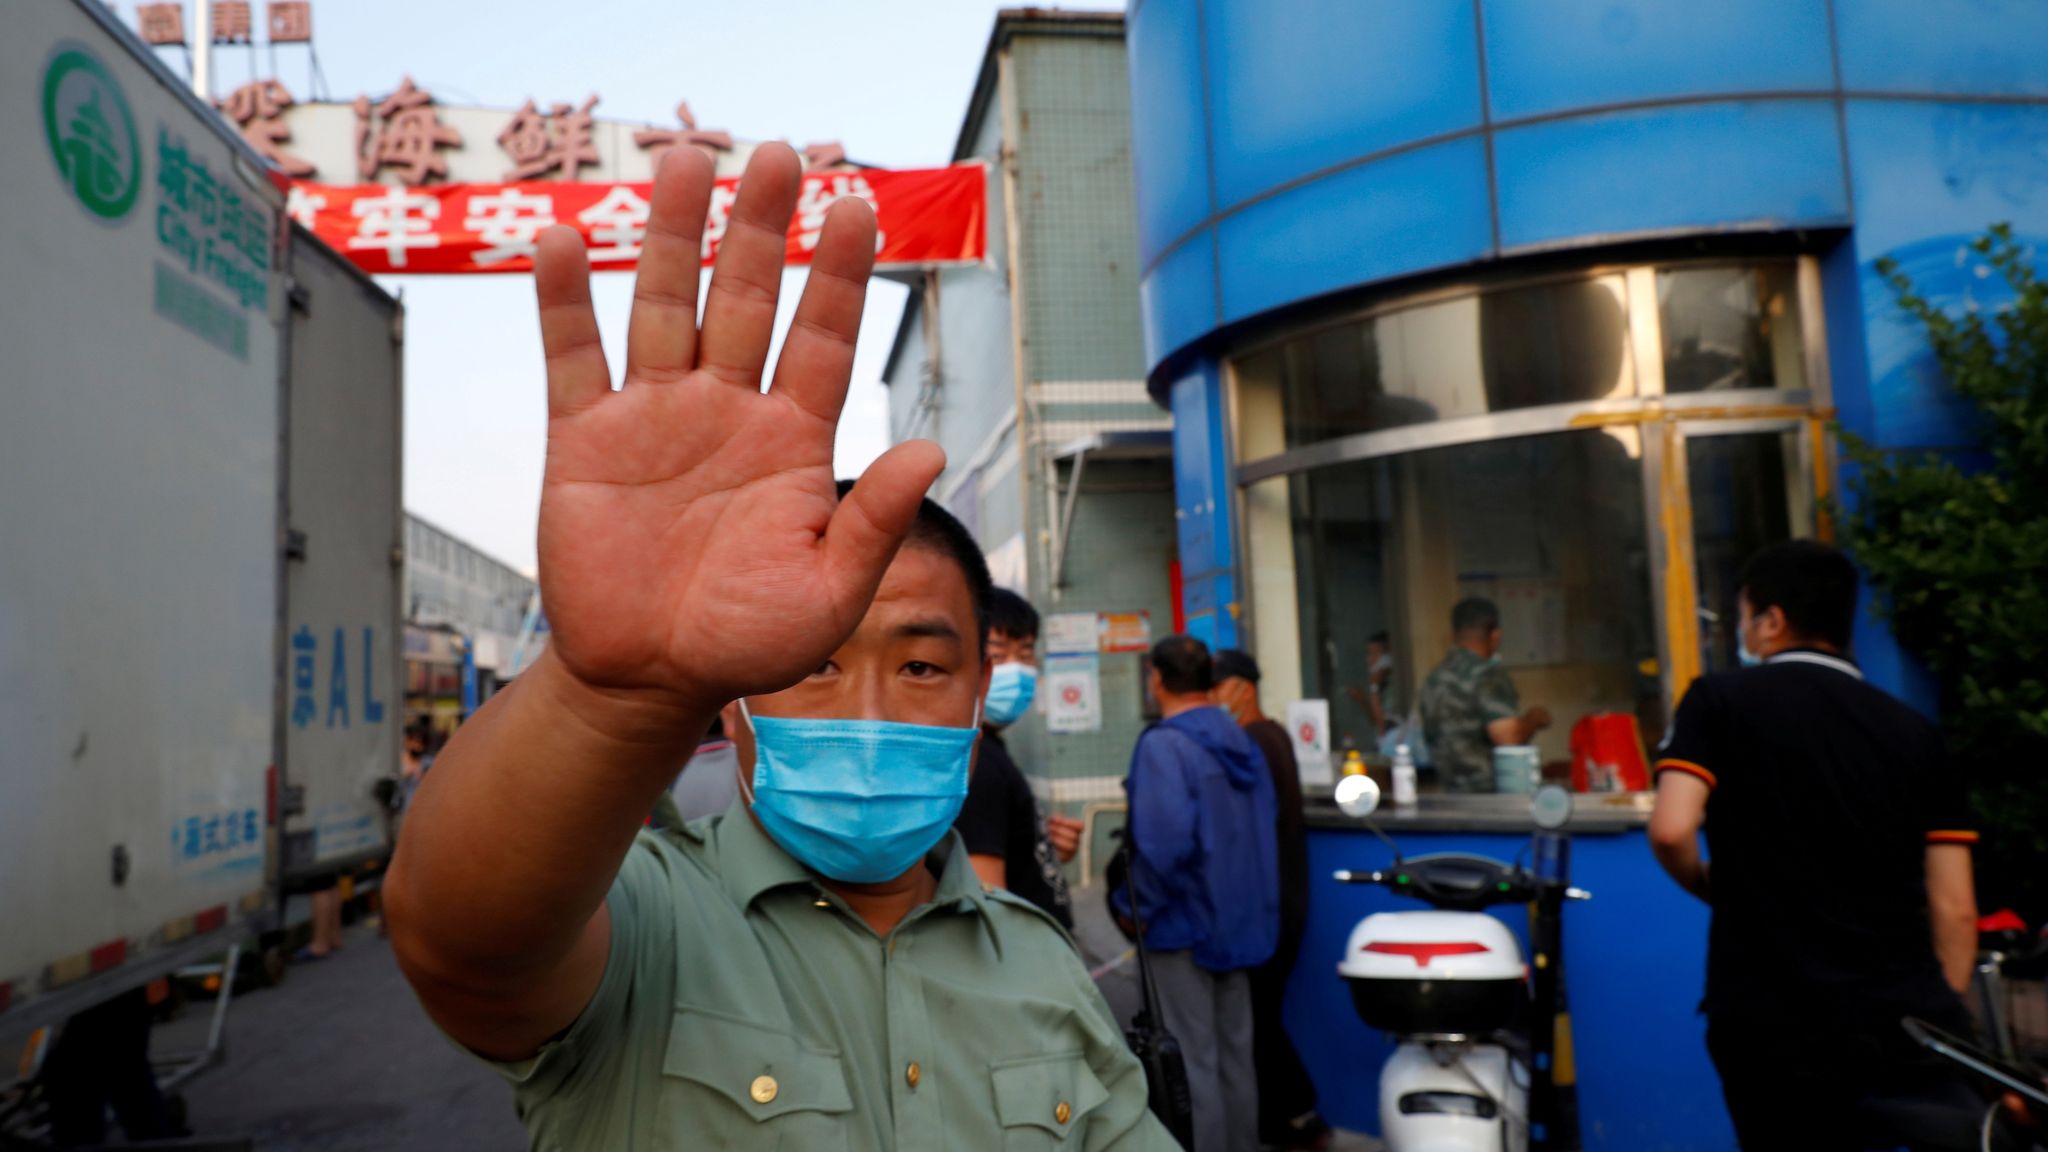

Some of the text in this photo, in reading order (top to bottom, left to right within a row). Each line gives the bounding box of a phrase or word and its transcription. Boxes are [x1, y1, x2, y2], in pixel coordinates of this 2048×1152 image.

[157, 203, 197, 273] City
[204, 236, 267, 312] Freight
[158, 124, 267, 271] 城市货运
